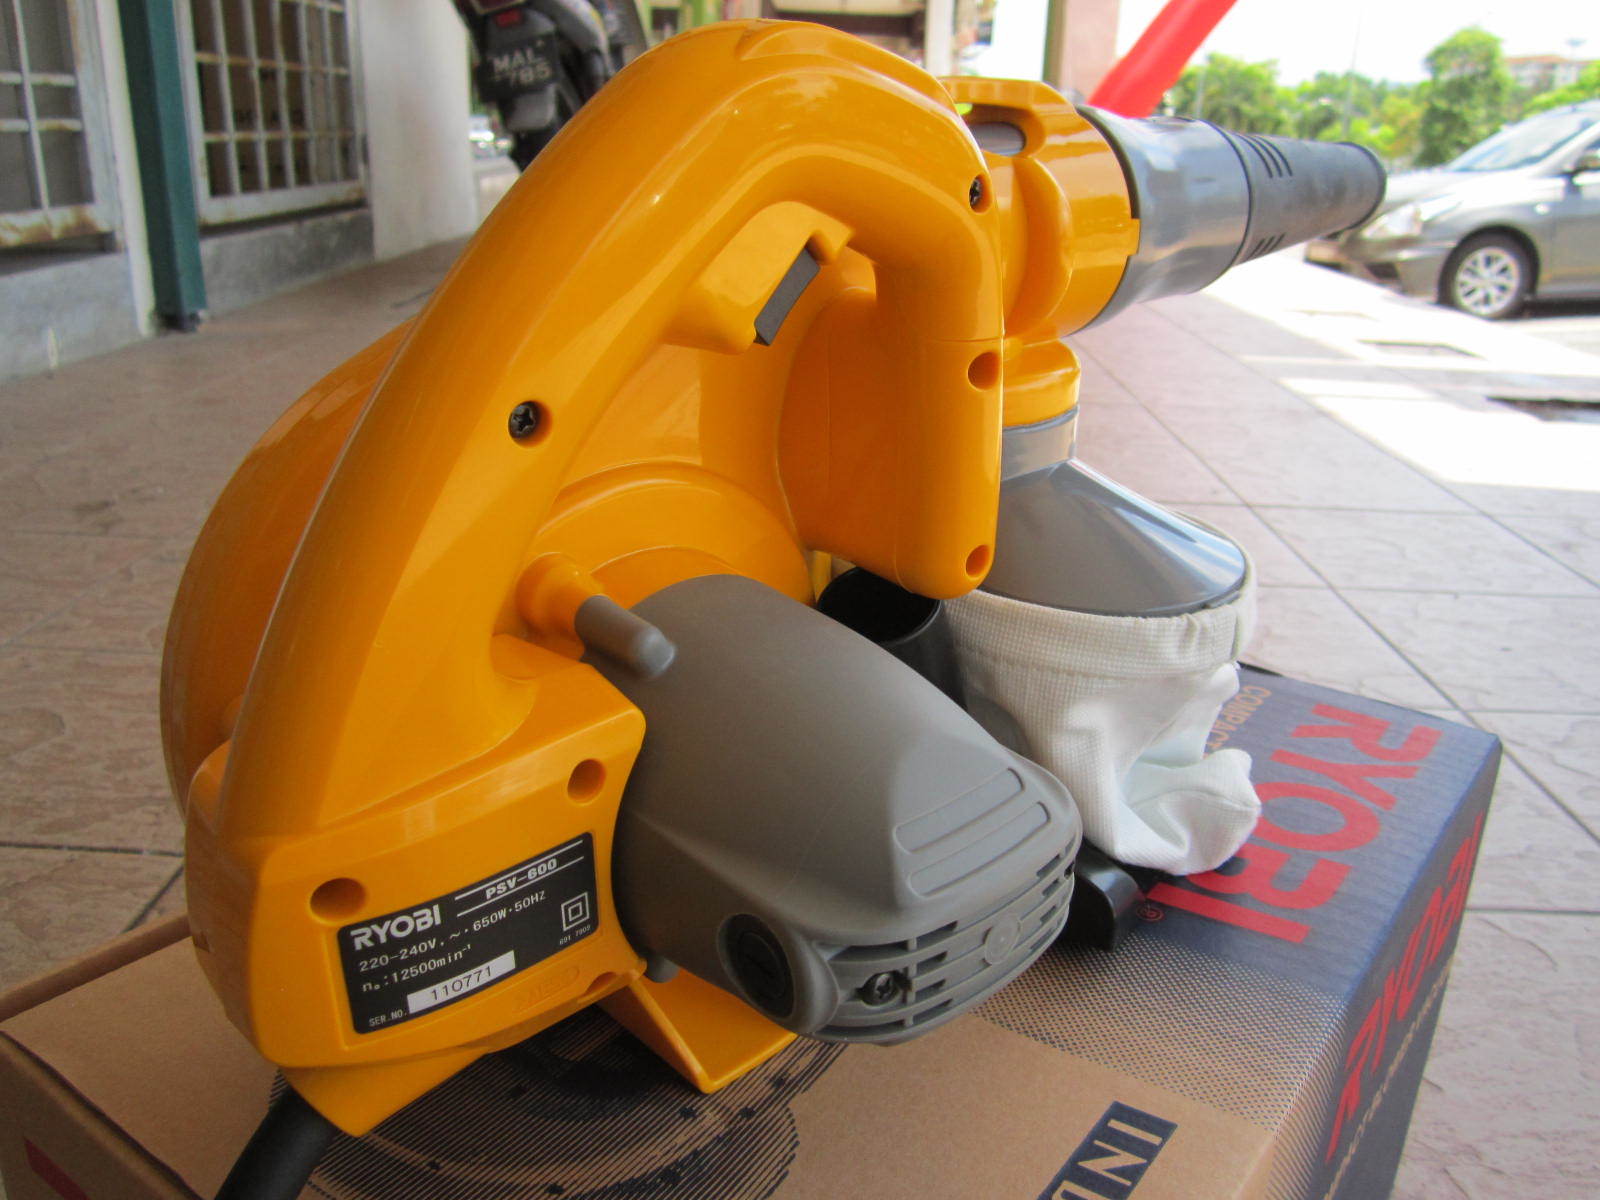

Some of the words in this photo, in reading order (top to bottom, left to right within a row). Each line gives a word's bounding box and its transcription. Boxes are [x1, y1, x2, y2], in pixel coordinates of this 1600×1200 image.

[1147, 703, 1443, 943] RYOBI
[486, 858, 557, 899] PSV-600
[350, 904, 441, 951] RYOBI
[431, 965, 493, 1001] 110771
